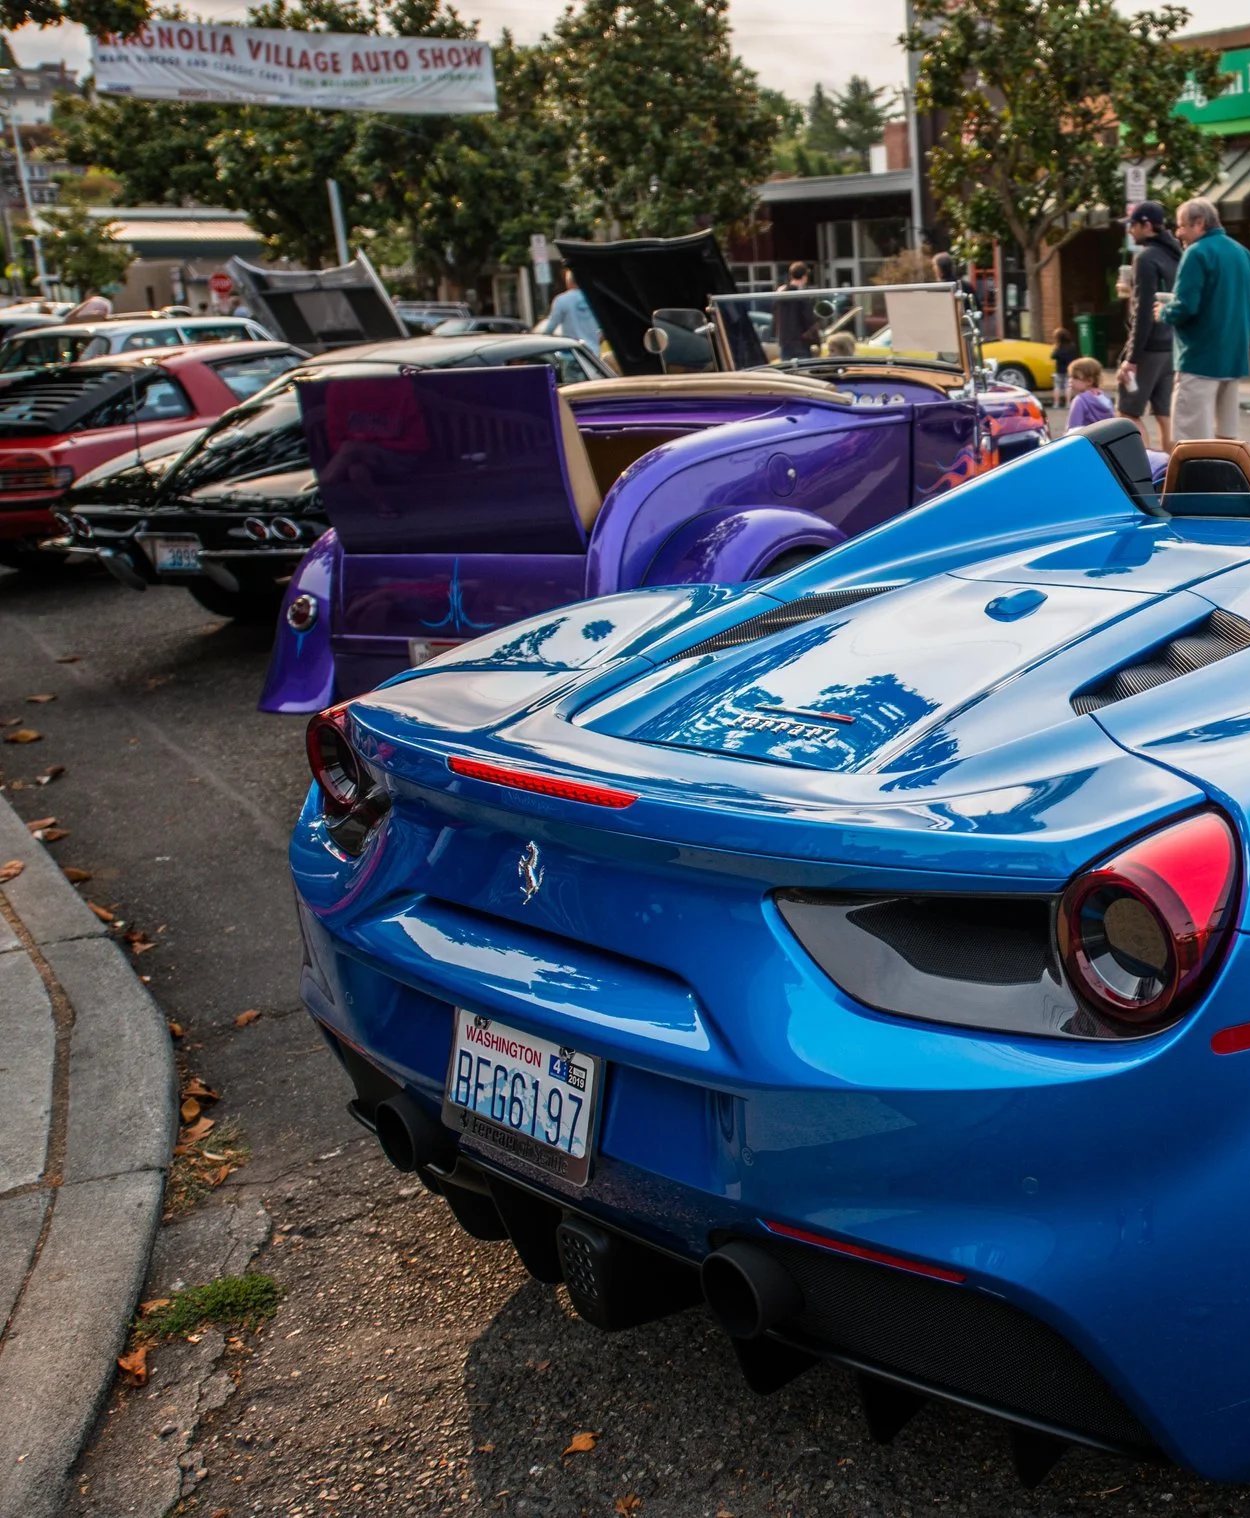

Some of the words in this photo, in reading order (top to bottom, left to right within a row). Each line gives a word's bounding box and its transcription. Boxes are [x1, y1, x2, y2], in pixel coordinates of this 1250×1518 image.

[248, 38, 342, 74] VILLAGE
[352, 50, 409, 74] AUTO
[418, 47, 482, 70] SHOW
[727, 713, 839, 743] Ferrari
[466, 1024, 542, 1068] WASHINGTON
[552, 1059, 562, 1075] 4
[568, 1074, 585, 1089] 2019
[455, 1049, 583, 1154] BFG6197
[471, 1117, 517, 1152] Ferrari
